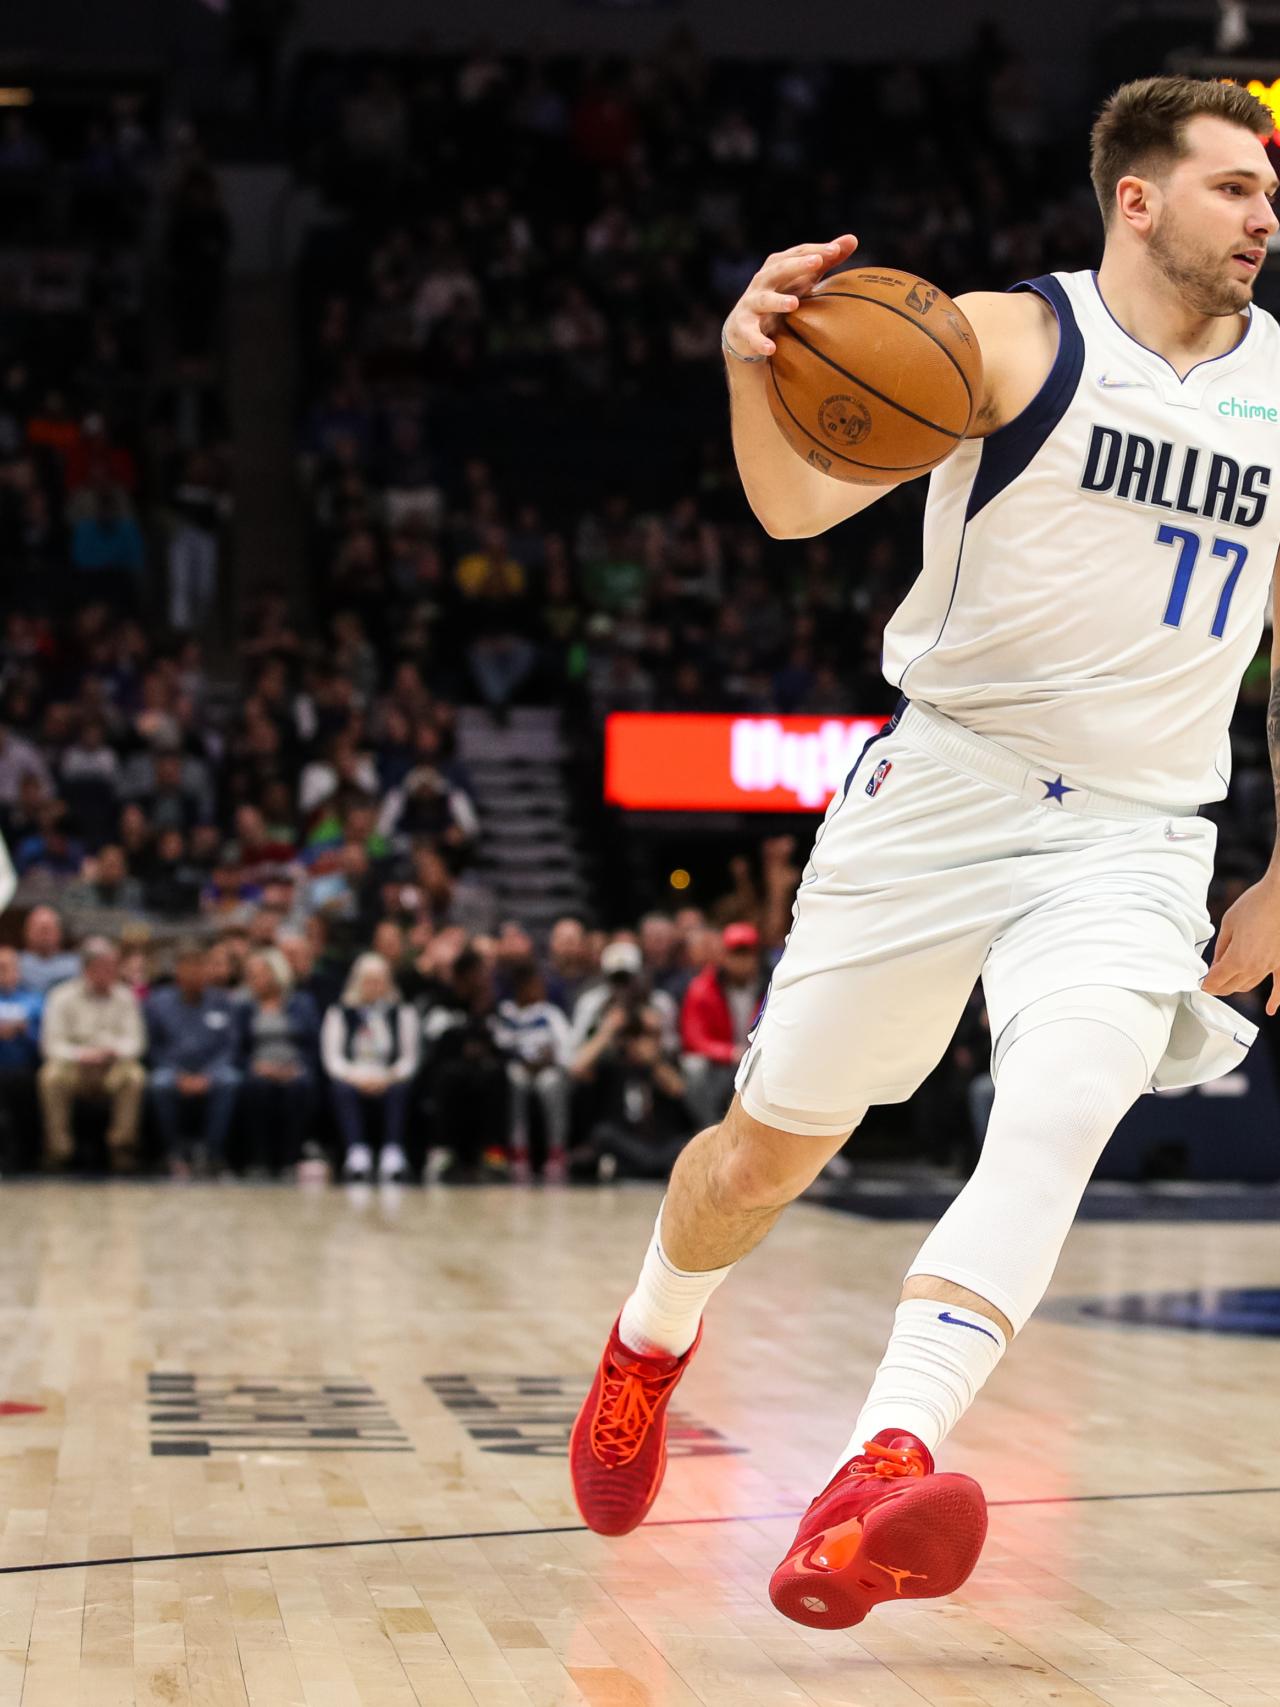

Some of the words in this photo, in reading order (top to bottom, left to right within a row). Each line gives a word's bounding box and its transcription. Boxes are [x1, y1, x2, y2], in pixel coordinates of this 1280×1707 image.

[1217, 397, 1279, 423] chime
[1079, 422, 1272, 530] DALLAS
[1153, 521, 1249, 641] 77
